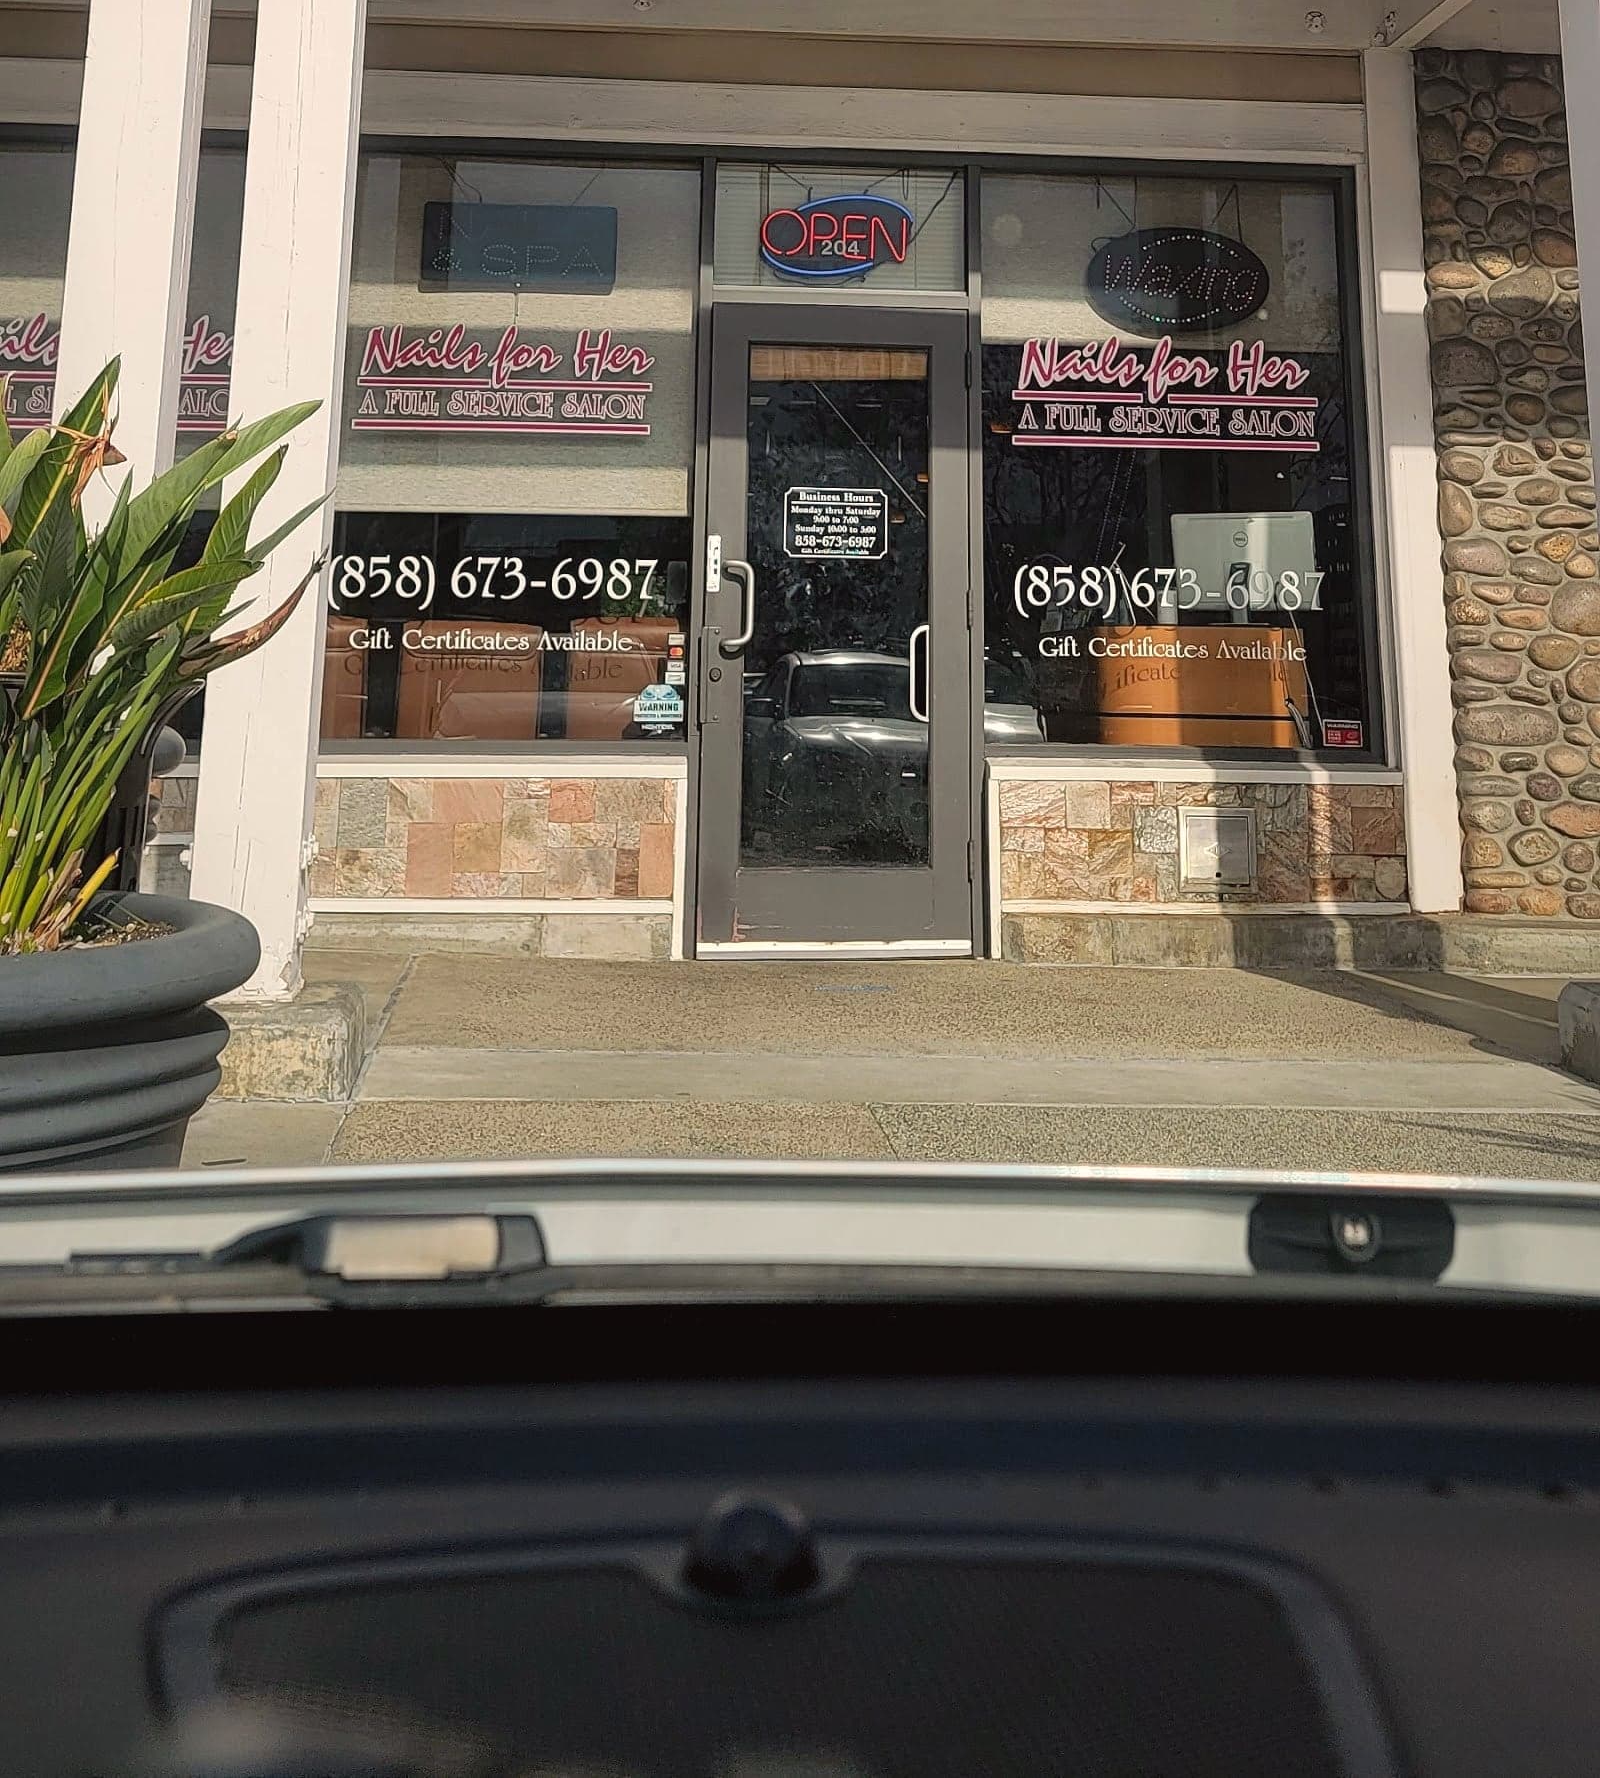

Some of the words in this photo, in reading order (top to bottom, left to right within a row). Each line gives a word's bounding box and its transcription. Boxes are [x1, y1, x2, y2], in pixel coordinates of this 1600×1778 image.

[760, 208, 909, 263] OPEN
[821, 239, 860, 256] 204
[482, 244, 604, 277] SPA
[1104, 254, 1259, 312] Waxing
[0, 312, 60, 366] ils
[183, 314, 233, 374] He
[360, 323, 488, 377] Nails
[489, 325, 563, 389] for
[574, 328, 656, 381] Her
[1017, 335, 1144, 390] Nails
[1144, 335, 1219, 404] for
[1227, 339, 1310, 396] Her
[358, 389, 378, 415] A
[384, 390, 440, 416] FULL
[446, 391, 555, 419] SERVICE
[561, 392, 646, 420] SALON
[1017, 403, 1040, 430] A
[1044, 403, 1102, 432] FULL
[1108, 406, 1221, 436] SERVICE
[1227, 408, 1316, 438] SALON
[791, 505, 823, 516] Monday
[825, 506, 843, 515] thru
[845, 507, 881, 518] Saturday
[799, 491, 840, 502] Business
[843, 492, 874, 502] Hours
[795, 524, 825, 534] Sunday
[795, 535, 876, 548] 858-673-6987
[327, 554, 436, 611] (858)
[450, 556, 659, 601] 673-6987
[1013, 564, 1117, 619] (858)
[1130, 567, 1327, 612] 673-6987
[348, 629, 393, 650] Gift
[402, 629, 530, 651] Certificates
[536, 631, 633, 652] Available
[1038, 636, 1081, 658] Gift
[1088, 636, 1209, 659] Certificates
[1215, 639, 1308, 662] Available
[639, 702, 679, 712] WARNING
